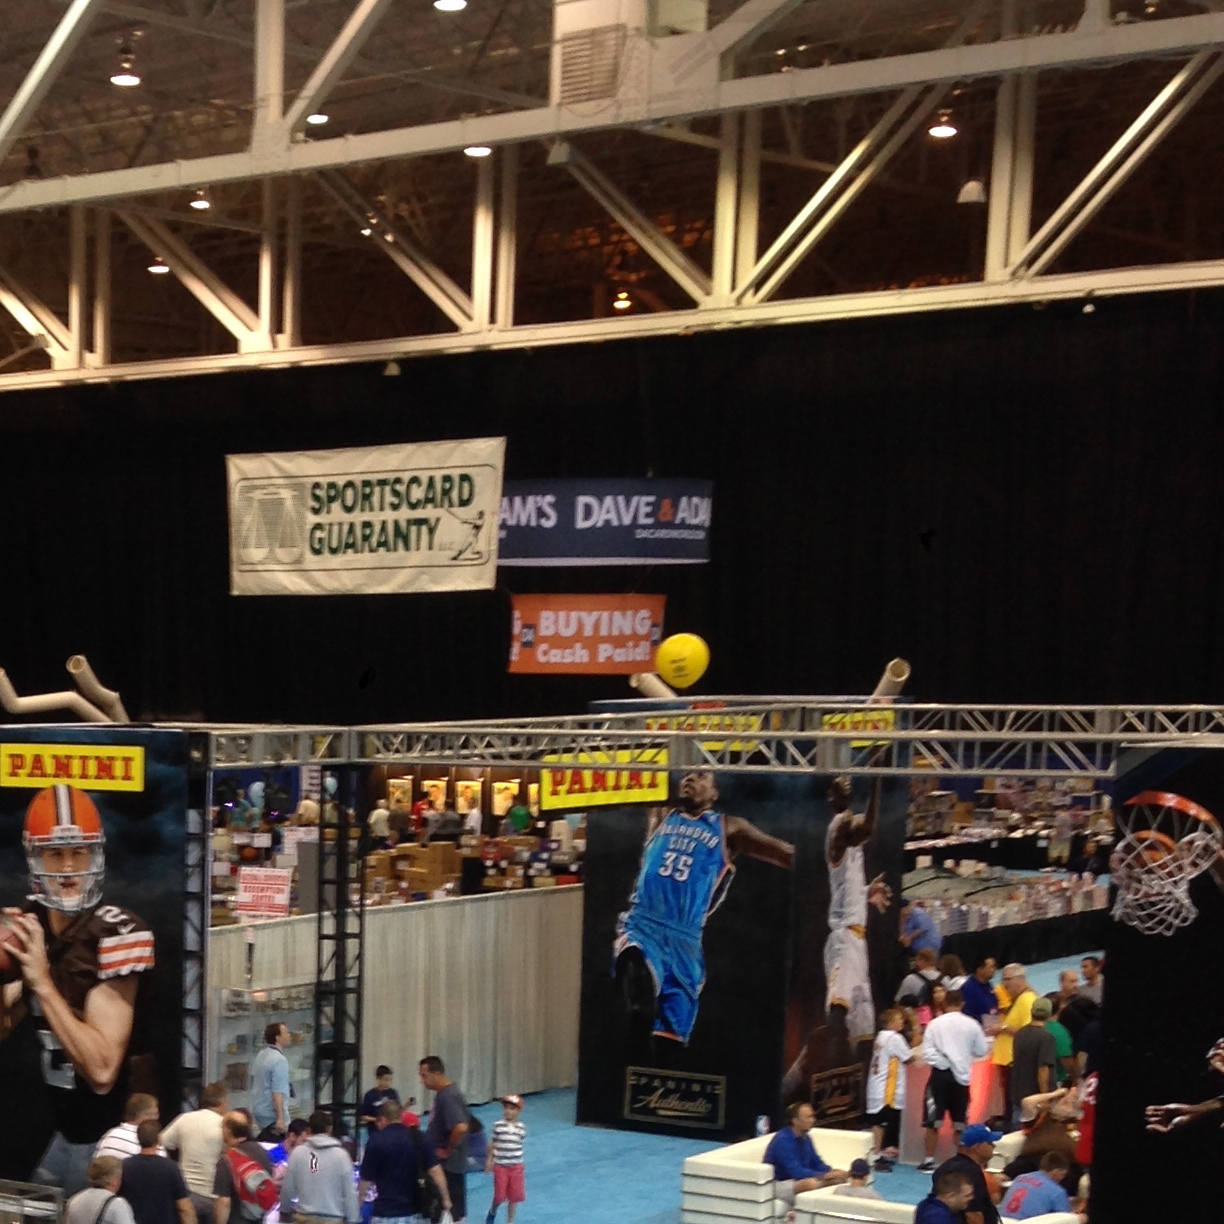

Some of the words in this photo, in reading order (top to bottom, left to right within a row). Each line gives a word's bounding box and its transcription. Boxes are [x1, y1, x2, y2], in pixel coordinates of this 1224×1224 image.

[310, 473, 475, 515] SPORTSCARD
[575, 494, 656, 529] DAVE
[658, 498, 674, 522] &
[309, 517, 441, 556] GUARANTY
[539, 609, 652, 637] BUYING
[536, 643, 590, 663] Cash
[597, 640, 651, 663] Paid!
[7, 753, 135, 781] PANINI
[550, 768, 659, 796] PANINI
[658, 852, 694, 882] 35
